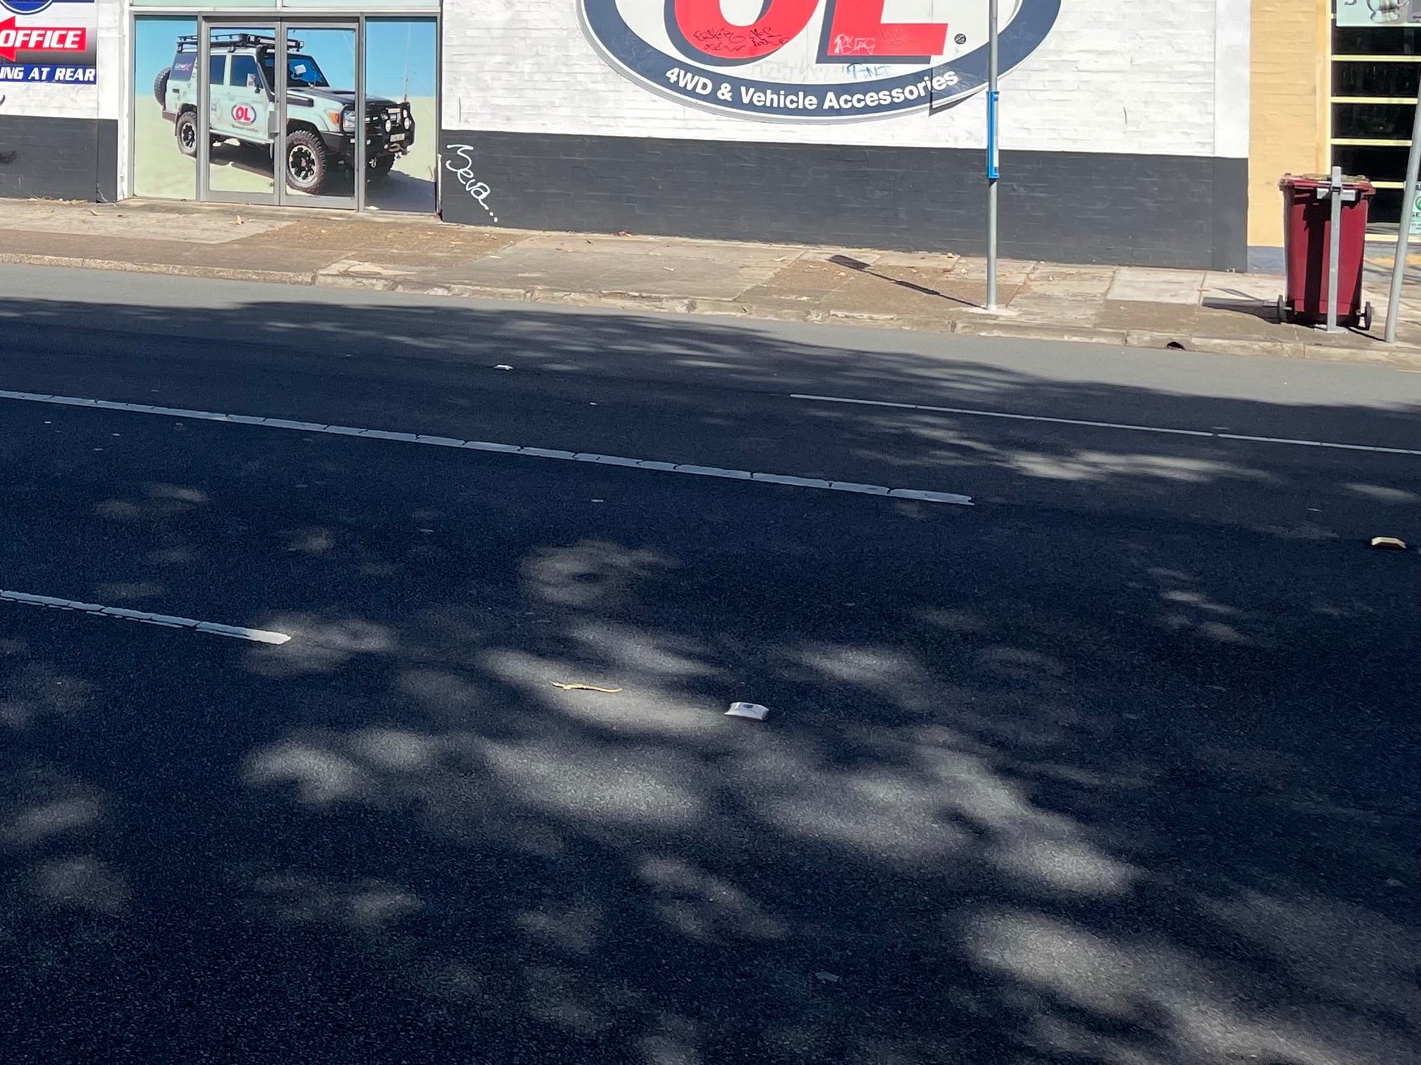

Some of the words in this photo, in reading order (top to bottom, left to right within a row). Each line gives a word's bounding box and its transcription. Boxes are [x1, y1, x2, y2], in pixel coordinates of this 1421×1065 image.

[28, 66, 49, 80] AT
[54, 66, 96, 81] REAR
[665, 66, 713, 96] 4WD
[716, 84, 733, 102] &
[740, 85, 818, 111] Vehicle
[822, 69, 960, 110] Accessories
[235, 105, 251, 122] OL
